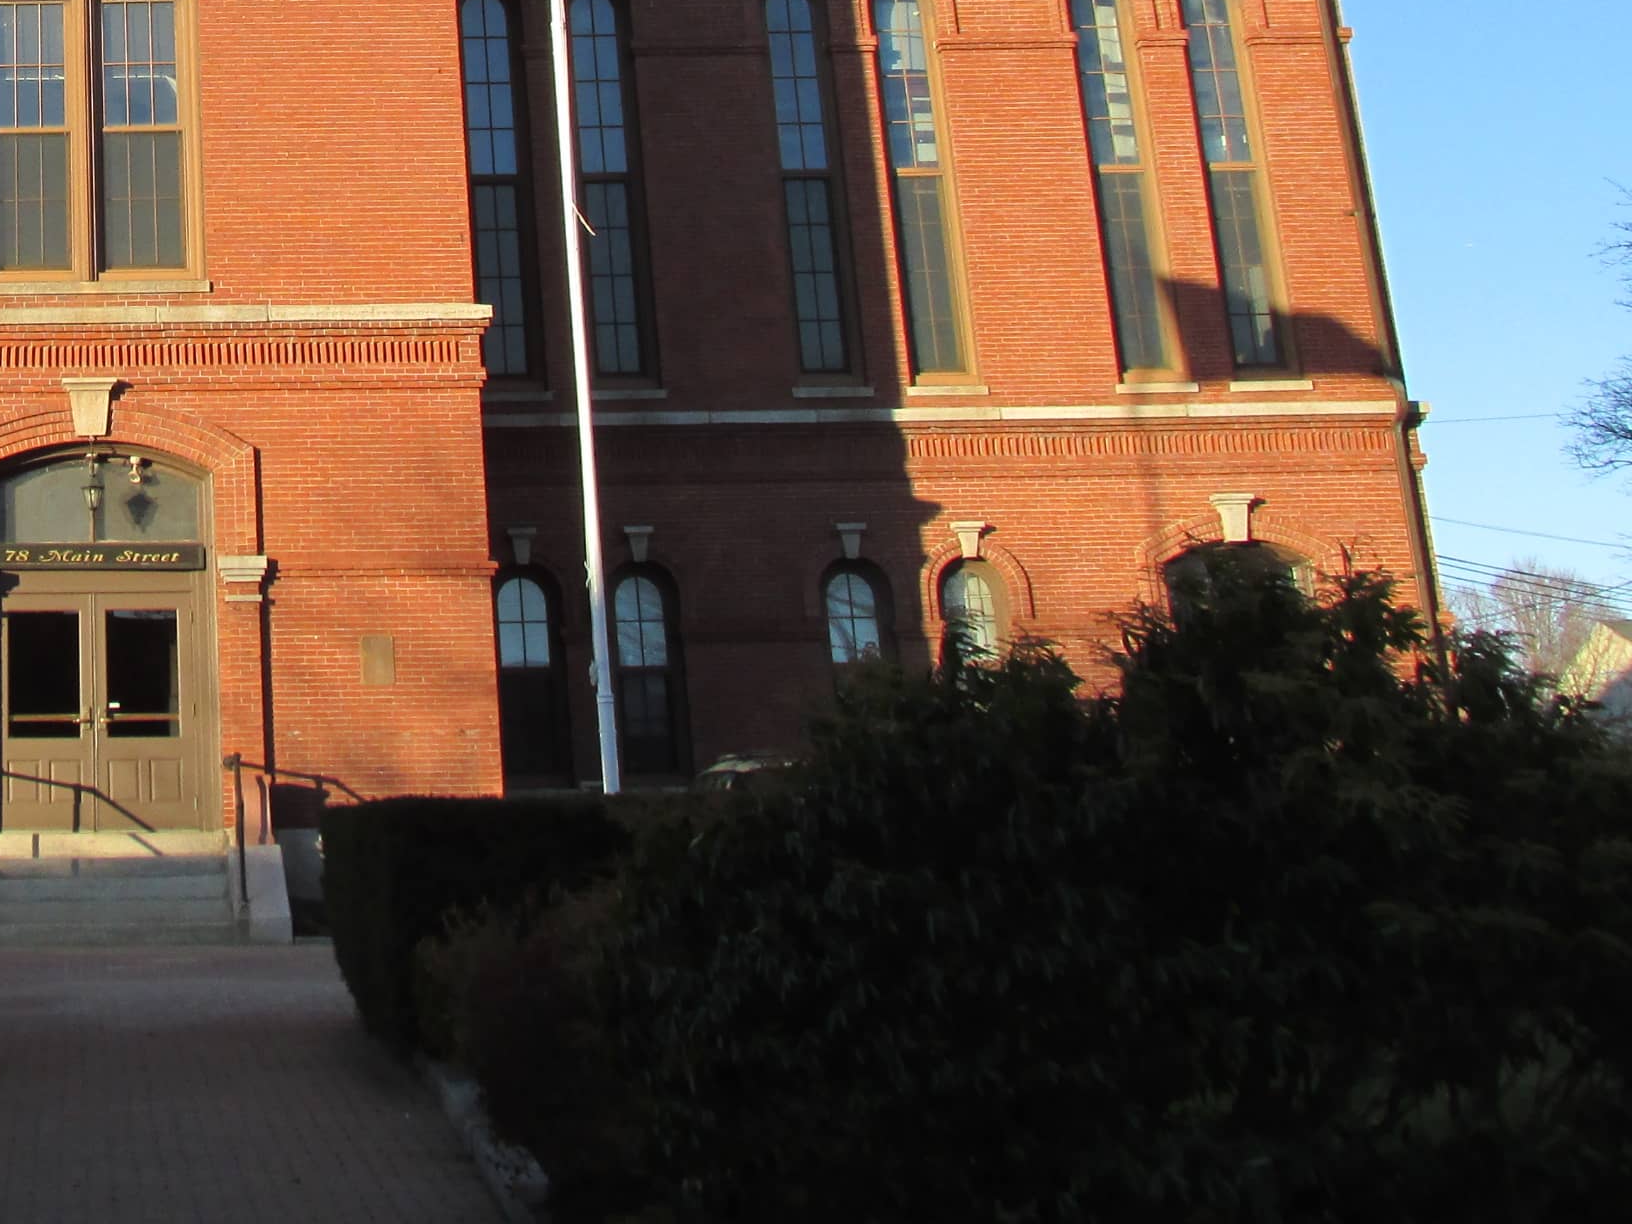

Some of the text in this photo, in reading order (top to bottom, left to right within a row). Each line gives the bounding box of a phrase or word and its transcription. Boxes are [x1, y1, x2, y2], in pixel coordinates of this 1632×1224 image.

[5, 549, 180, 562] 78 Main Street
